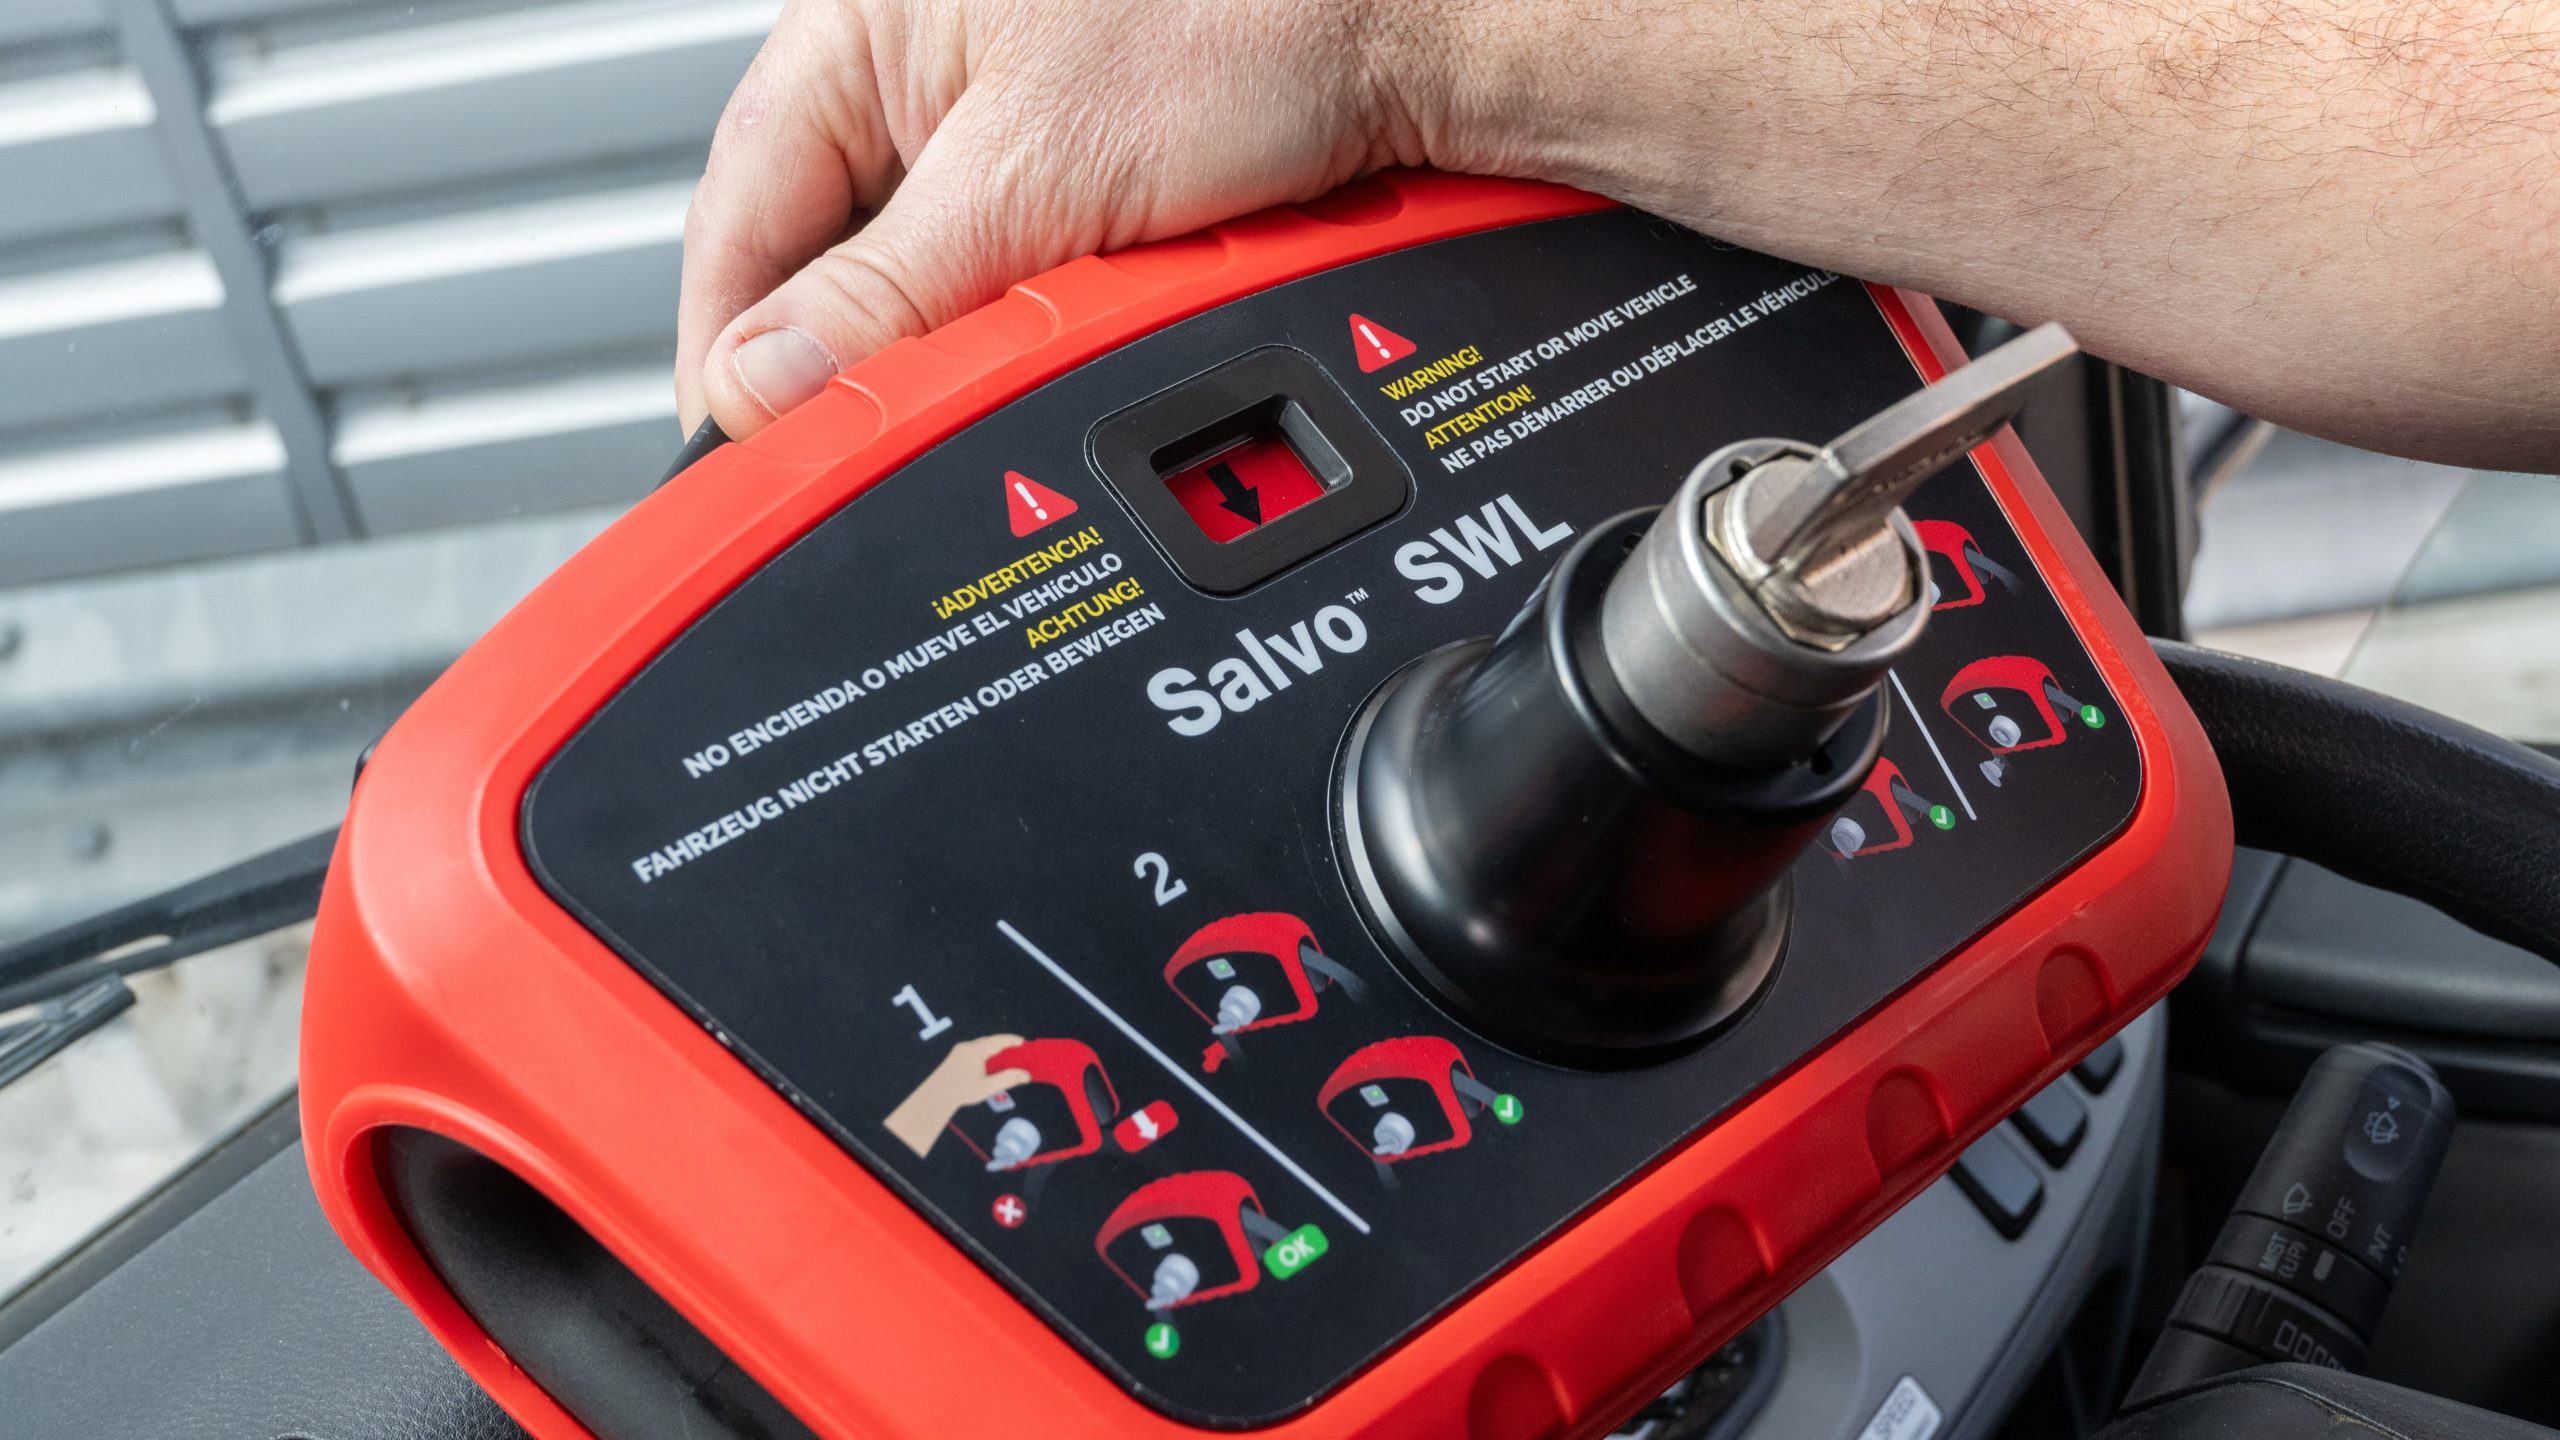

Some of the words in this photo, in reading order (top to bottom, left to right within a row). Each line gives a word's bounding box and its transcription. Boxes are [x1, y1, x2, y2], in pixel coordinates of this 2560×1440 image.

[1380, 346, 1483, 400] WARNING!
[1400, 402, 1435, 426] DO
[1432, 375, 1479, 411] NOT
[1477, 350, 1537, 389] START
[1537, 332, 1570, 359] OR
[1567, 307, 1623, 346] MOVE
[1619, 275, 1696, 319] VEHICLE
[1425, 384, 1535, 449] ATTENTION!
[1440, 447, 1475, 473] NE
[1471, 429, 1512, 458] PAS
[1508, 379, 1616, 439] DÉMARRER
[1612, 362, 1643, 386] OU
[1643, 319, 1735, 373] DÉPLACER
[1730, 306, 1758, 327] LE
[1393, 493, 1575, 605] SWL
[1027, 577, 1144, 648] ACHTUNG!
[683, 744, 730, 778] NO
[728, 680, 866, 756] ENCIENDA
[862, 668, 886, 689] O
[884, 624, 978, 679] MUEVE
[974, 611, 1010, 636] EL
[632, 797, 783, 883] FAHRZEUG
[778, 752, 863, 809] NICHT
[863, 696, 979, 766] STARTEN
[977, 663, 1049, 707] ODER
[1044, 603, 1165, 674] BEWEGEN
[1133, 851, 1188, 907] 2
[891, 983, 953, 1041] 1
[2327, 1197, 2356, 1239] OFF
[1277, 1235, 1316, 1269] OK
[2259, 1231, 2283, 1273] MIST
